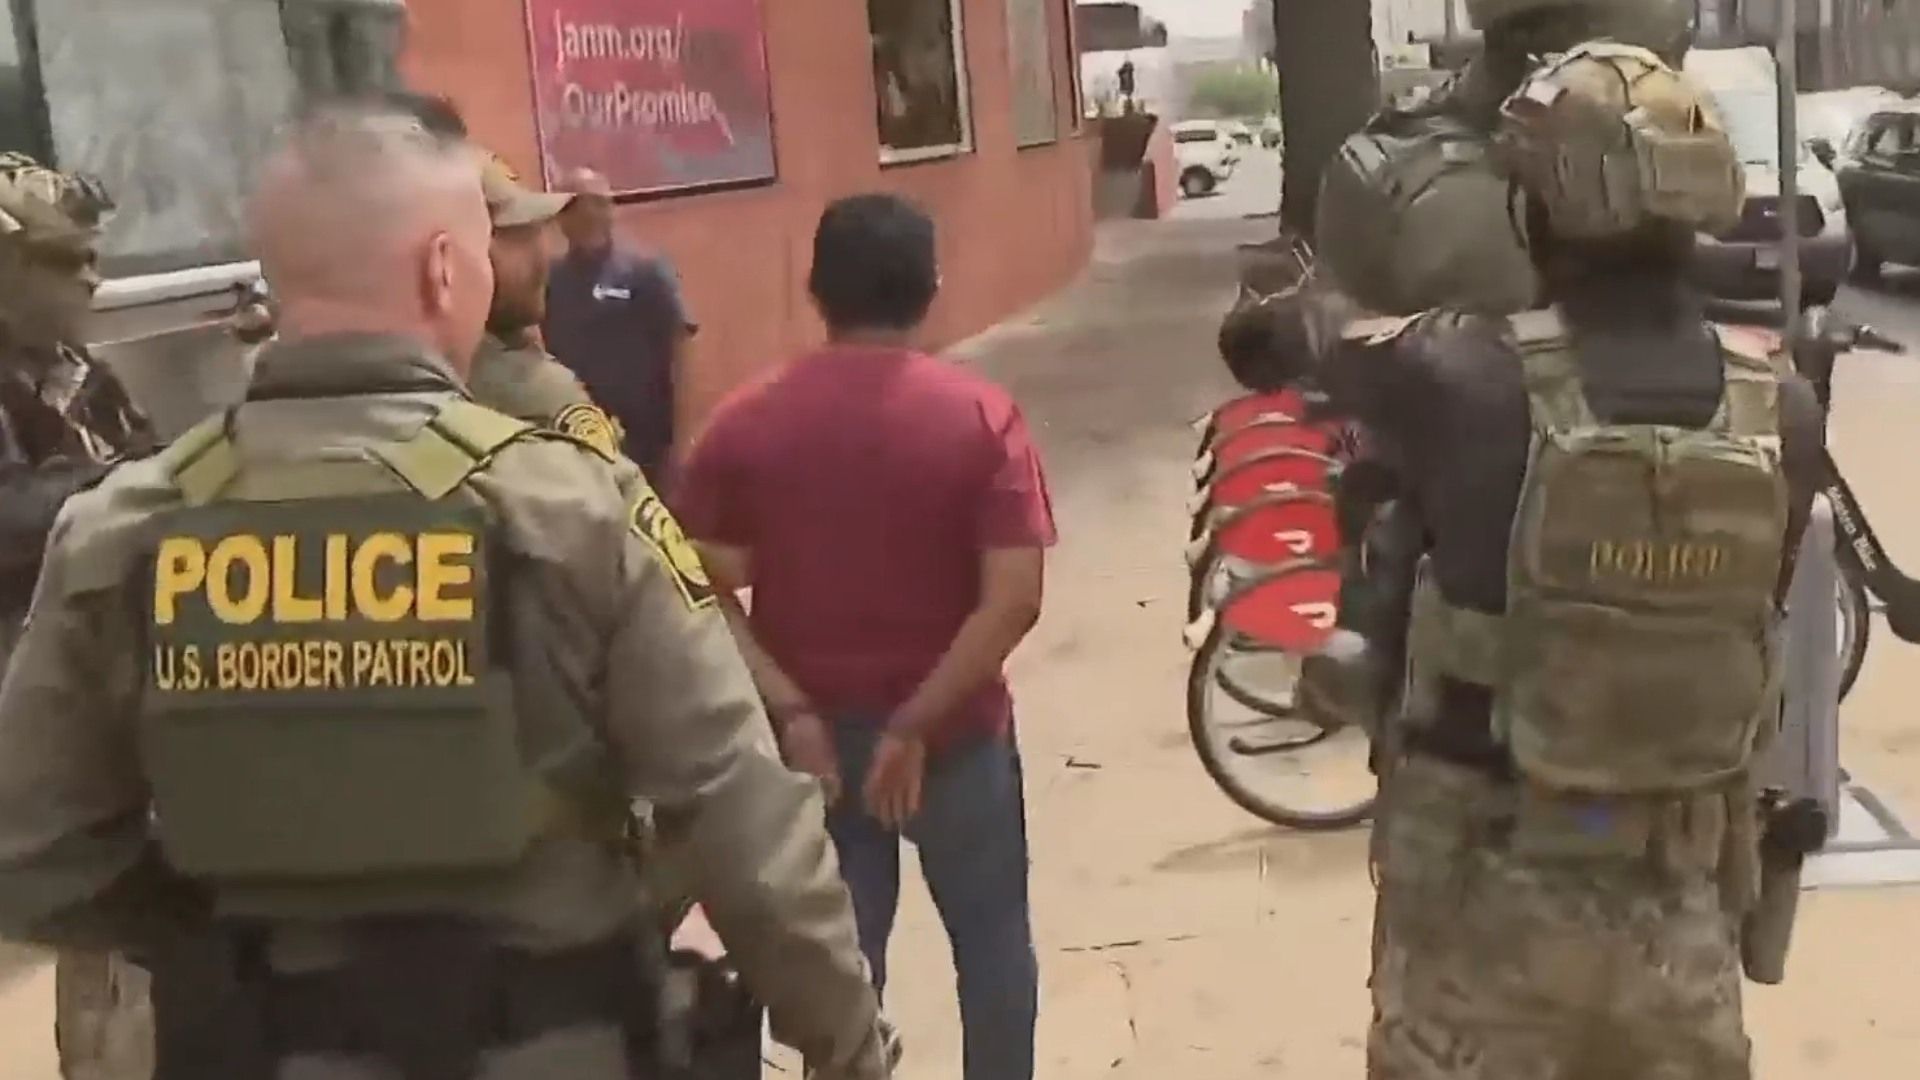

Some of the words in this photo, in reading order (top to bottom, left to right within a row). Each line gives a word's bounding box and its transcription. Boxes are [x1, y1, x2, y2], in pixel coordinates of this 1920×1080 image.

[154, 532, 474, 625] POLICE
[154, 644, 210, 690] U.S.
[216, 640, 345, 690] BORDER
[352, 638, 476, 688] PATROL
